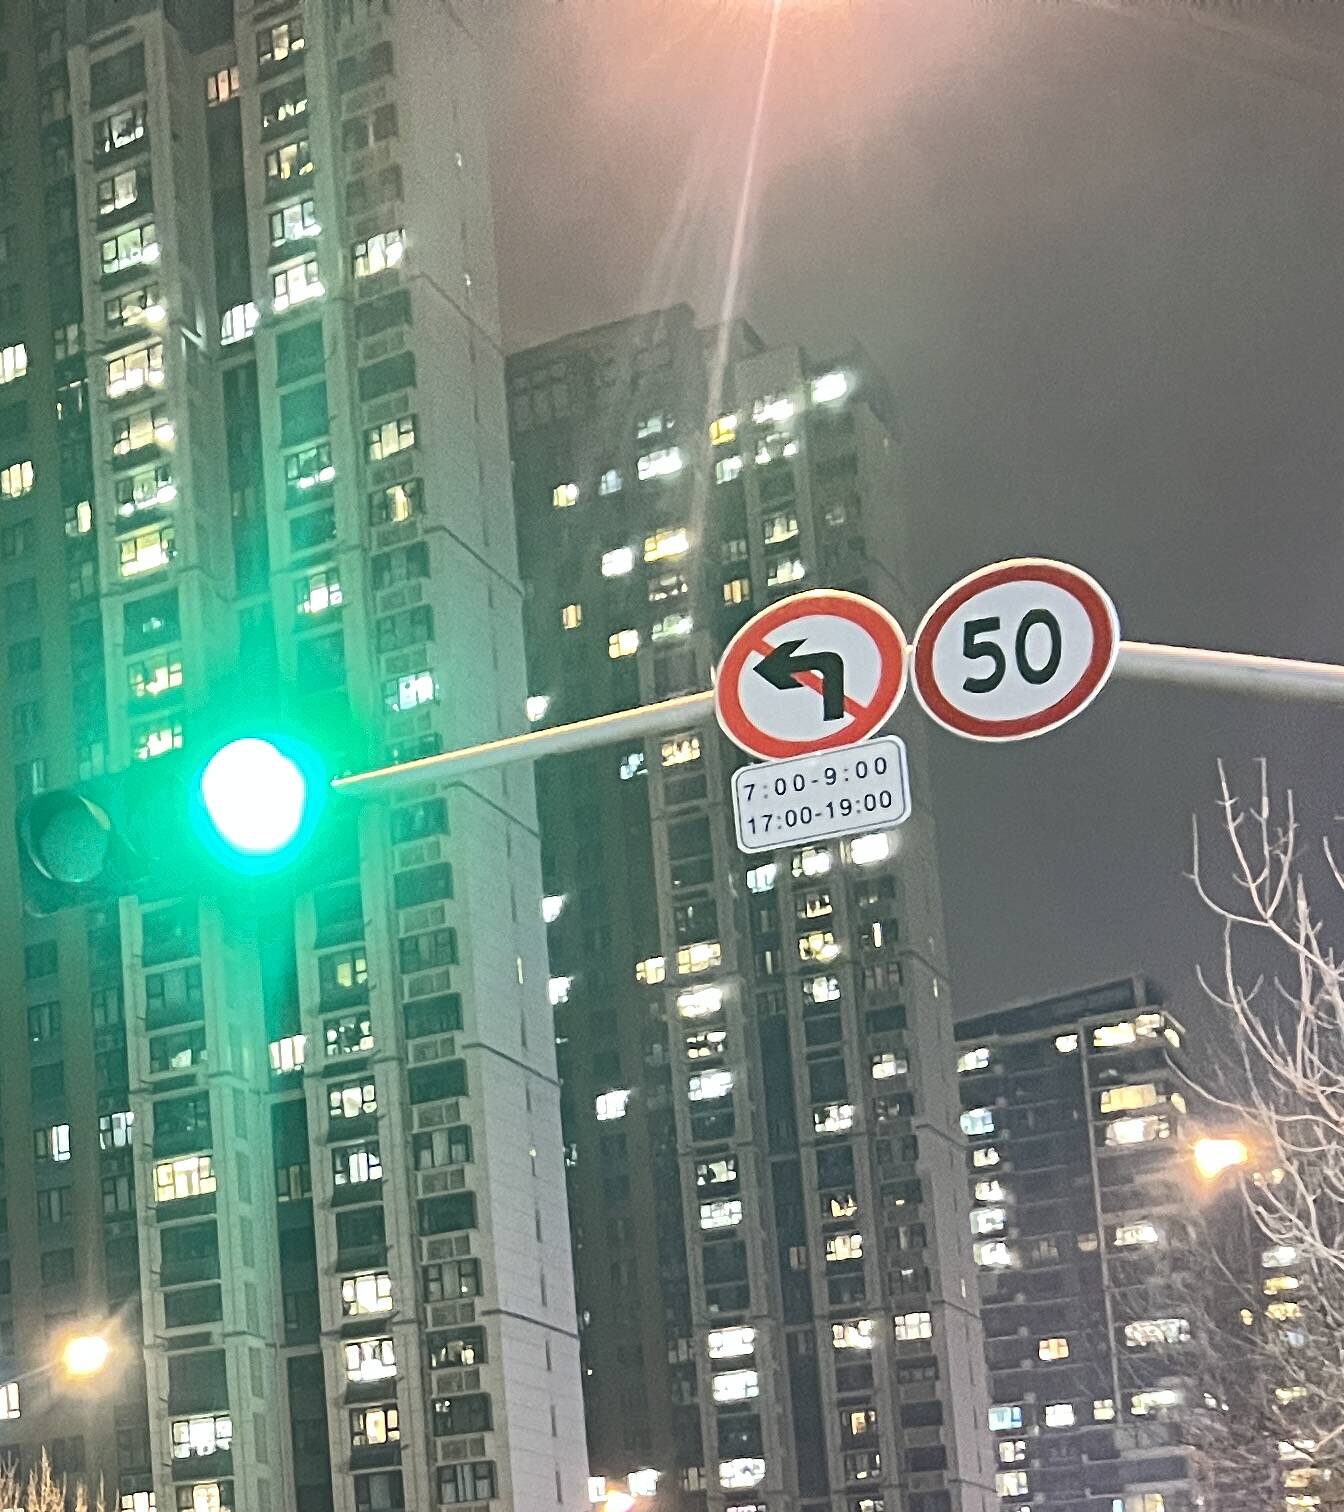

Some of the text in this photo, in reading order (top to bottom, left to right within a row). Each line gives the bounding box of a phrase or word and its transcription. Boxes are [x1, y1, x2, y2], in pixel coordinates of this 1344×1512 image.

[961, 608, 1063, 694] 50
[743, 756, 889, 802] 7:00-9:00
[747, 789, 893, 835] 17:00-19:00
